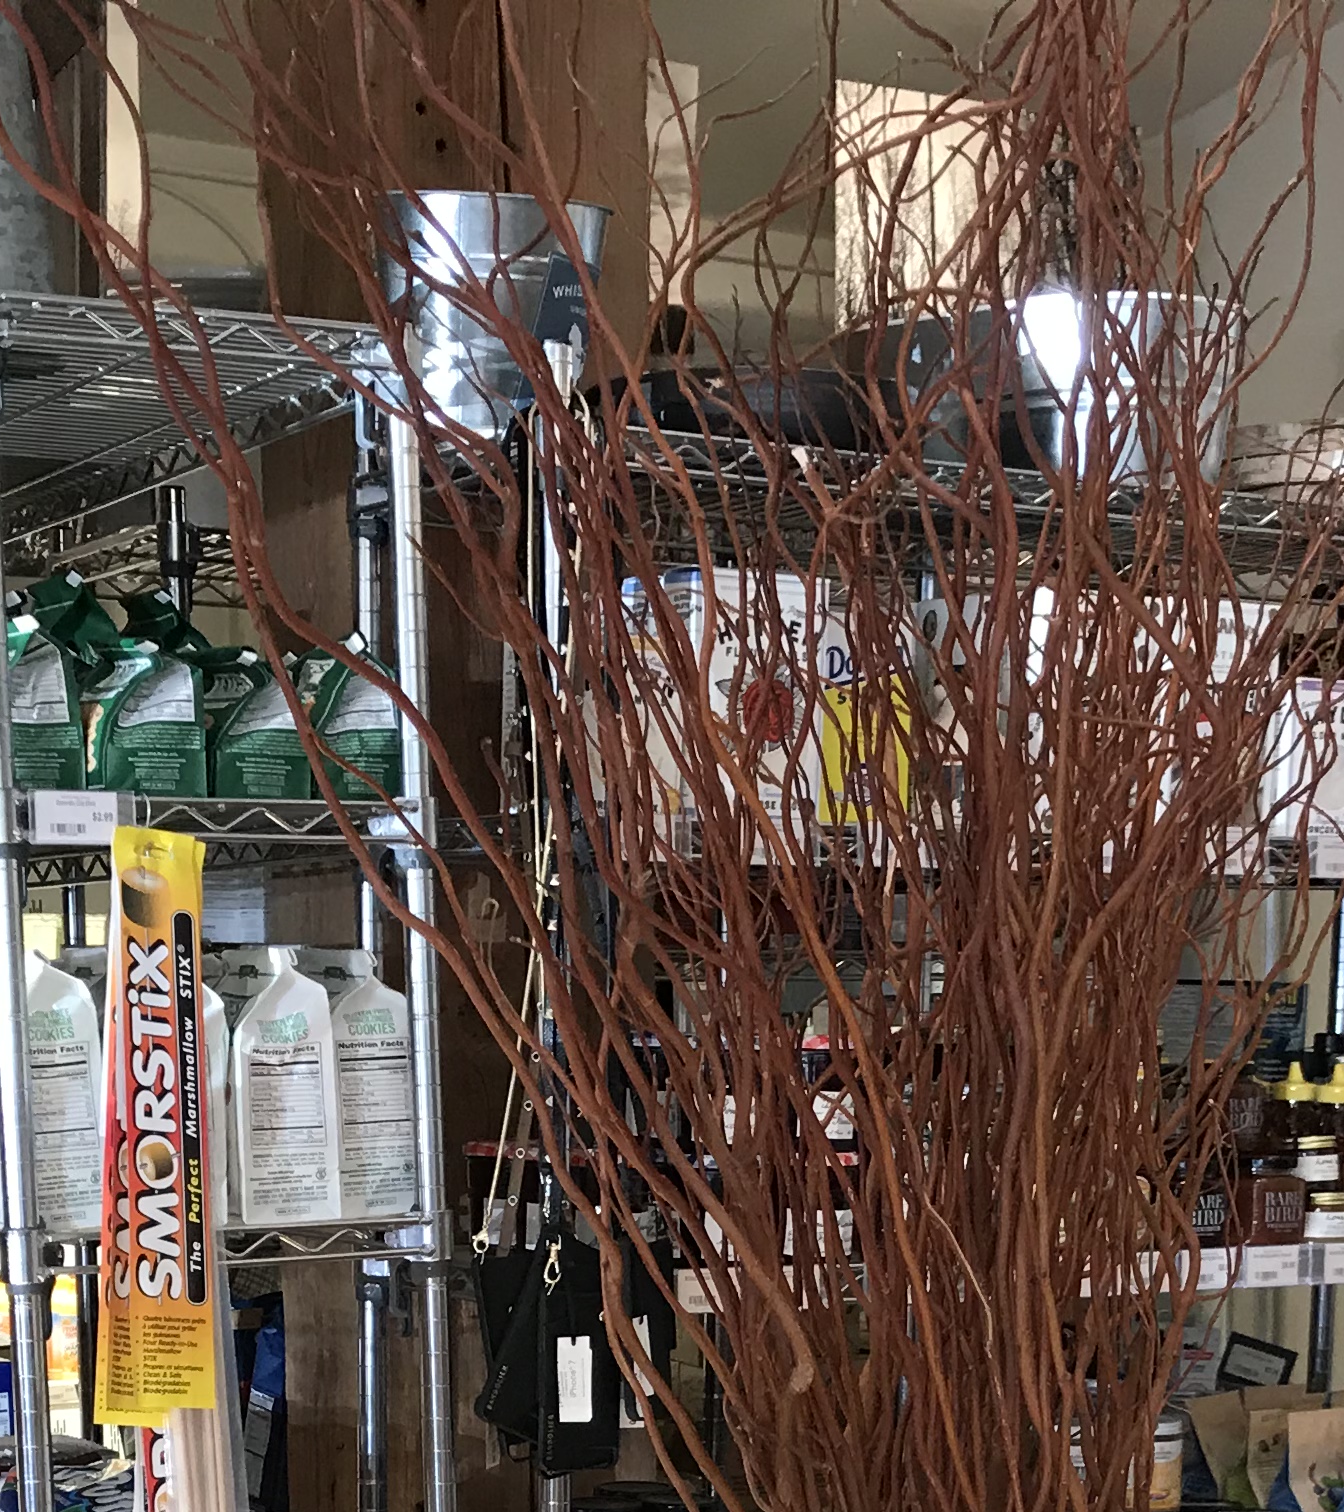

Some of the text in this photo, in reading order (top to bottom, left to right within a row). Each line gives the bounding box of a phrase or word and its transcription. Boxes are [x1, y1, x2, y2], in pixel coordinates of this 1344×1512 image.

[347, 1022, 396, 1036] COOKIES
[60, 1044, 85, 1054] Facts
[337, 1039, 404, 1050] Nutrition Facts
[181, 1015, 199, 1139] Marshmallow
[188, 1157, 201, 1225] Perfect
[1264, 1190, 1303, 1208] RARE
[1264, 1206, 1304, 1224] BIRD
[188, 1239, 202, 1273] The
